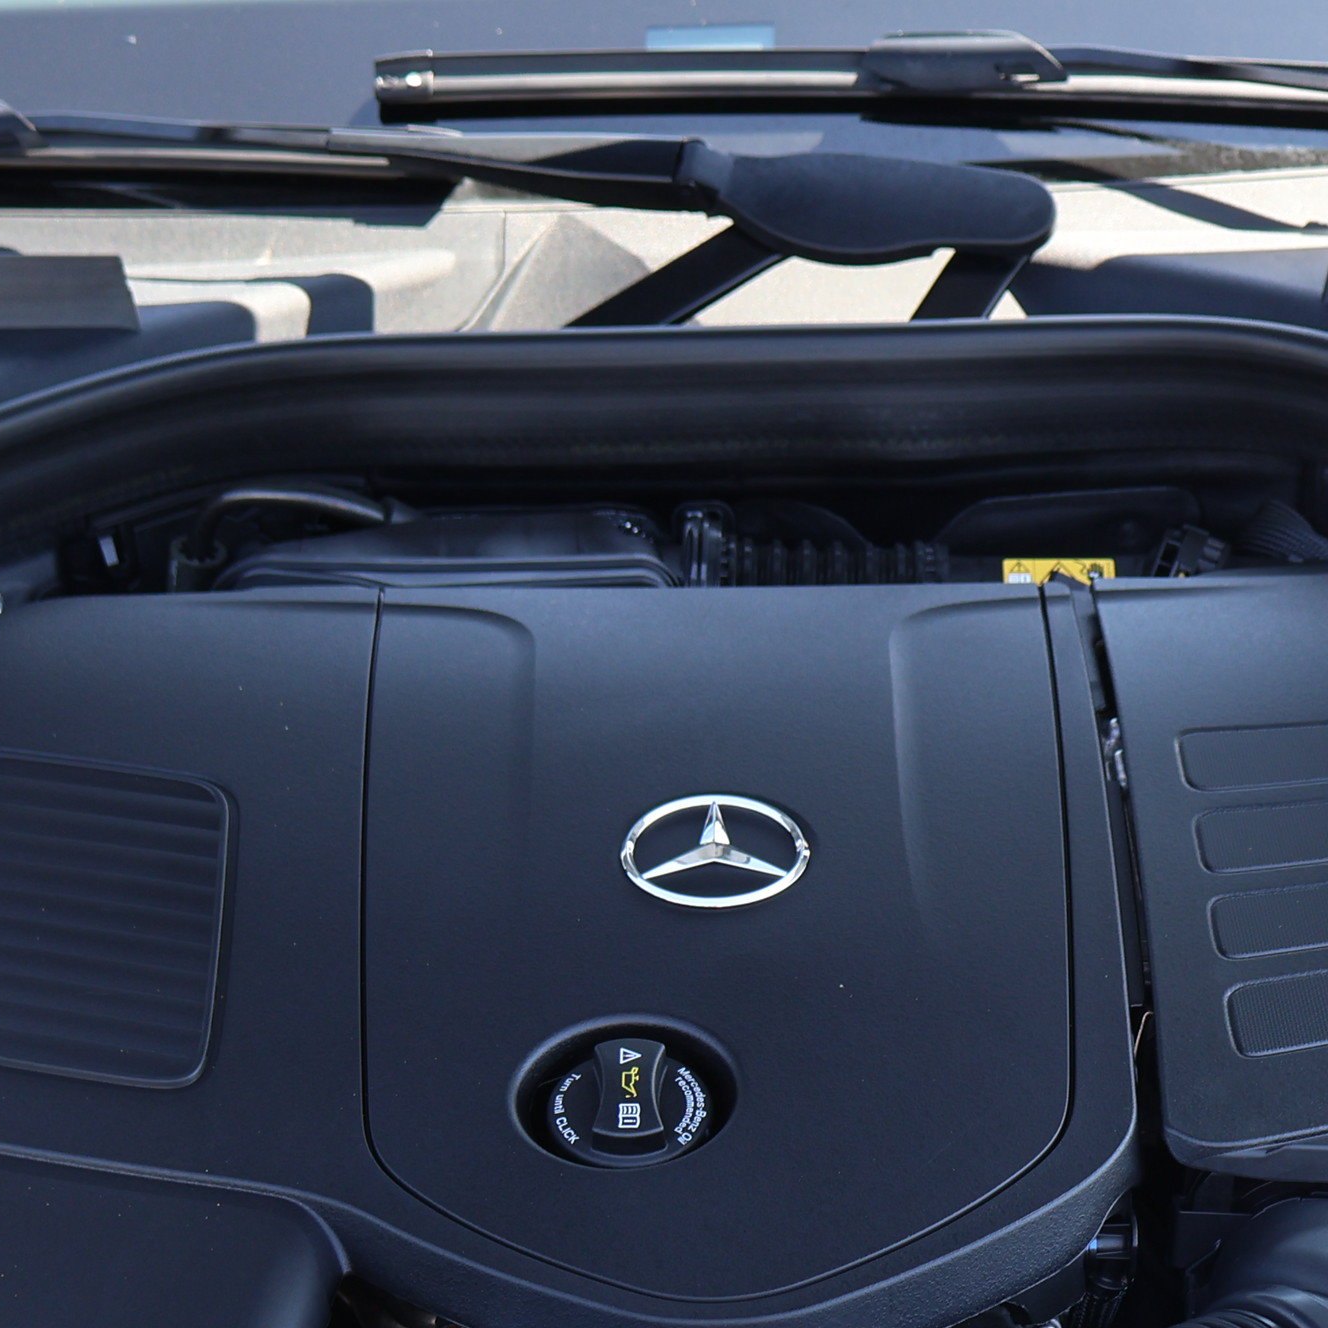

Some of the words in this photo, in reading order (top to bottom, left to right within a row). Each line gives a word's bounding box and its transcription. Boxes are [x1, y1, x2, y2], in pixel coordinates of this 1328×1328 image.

[559, 1073, 582, 1092] Turn
[554, 1093, 565, 1115] until
[674, 1076, 694, 1135] recommended
[677, 1066, 707, 1133] Mercedes-Benz
[555, 1116, 580, 1145] CLICK
[677, 1131, 693, 1146] Oil
